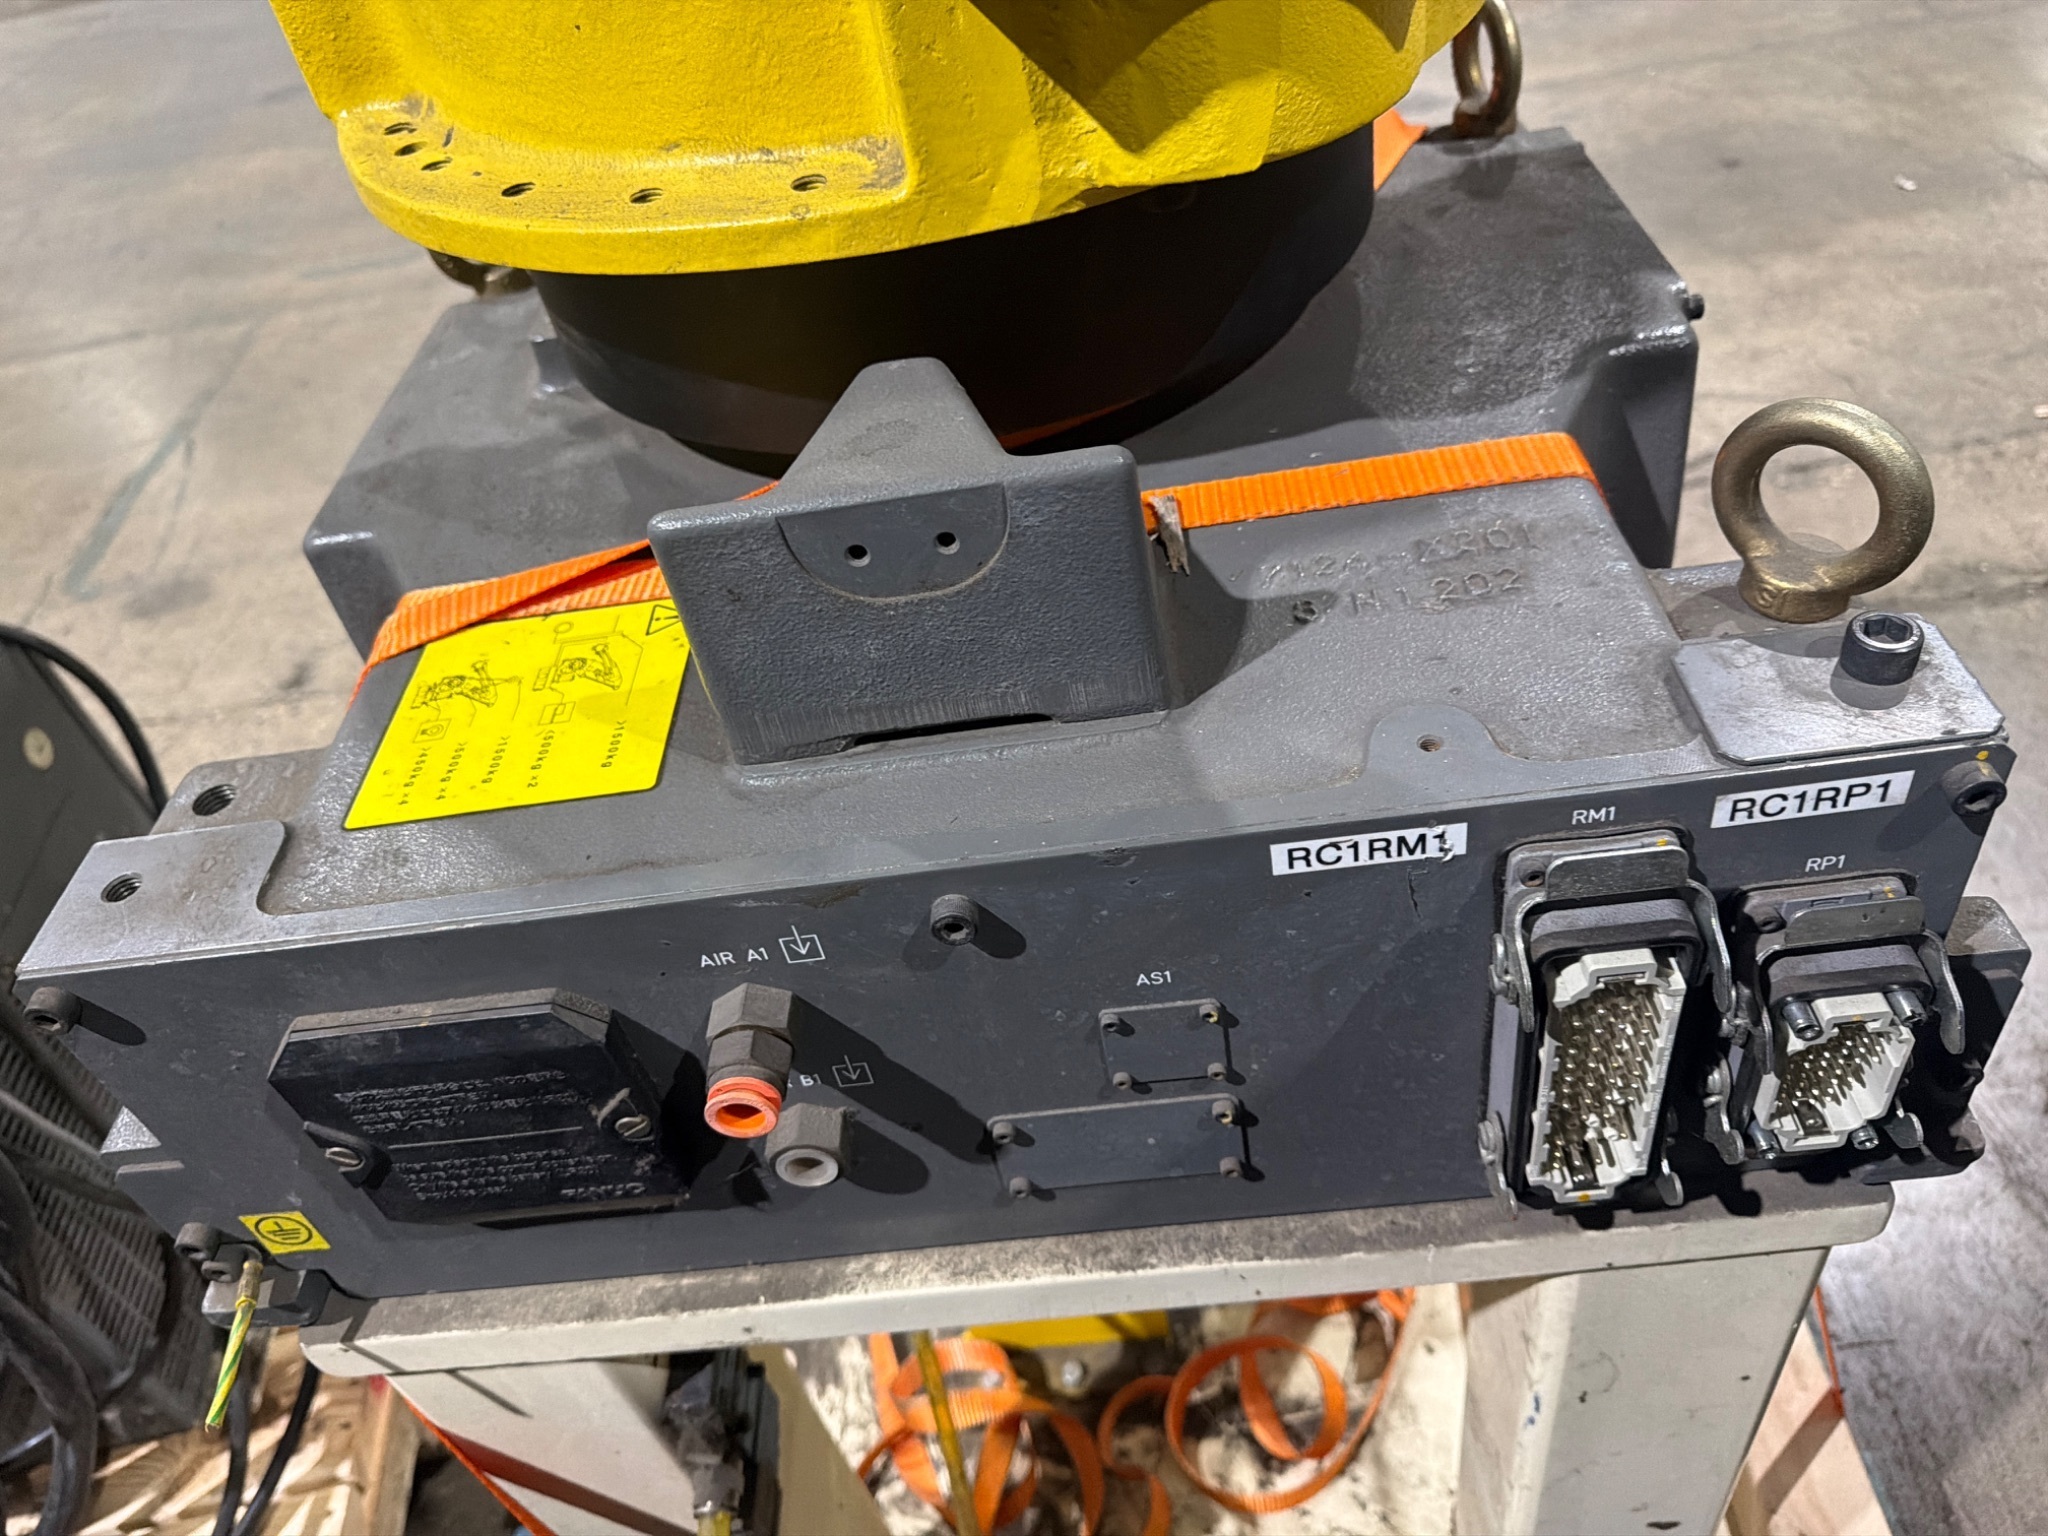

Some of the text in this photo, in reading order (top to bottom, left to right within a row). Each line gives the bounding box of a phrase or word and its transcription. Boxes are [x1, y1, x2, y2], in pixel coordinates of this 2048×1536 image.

[1728, 779, 1893, 823] RC1RP1
[1571, 805, 1616, 825] RM1
[1286, 831, 1447, 870] RC1RM1
[1805, 854, 1847, 873] RP1
[700, 947, 770, 968] AIR A1
[1136, 970, 1172, 987] AS1
[799, 1073, 822, 1088] B1
